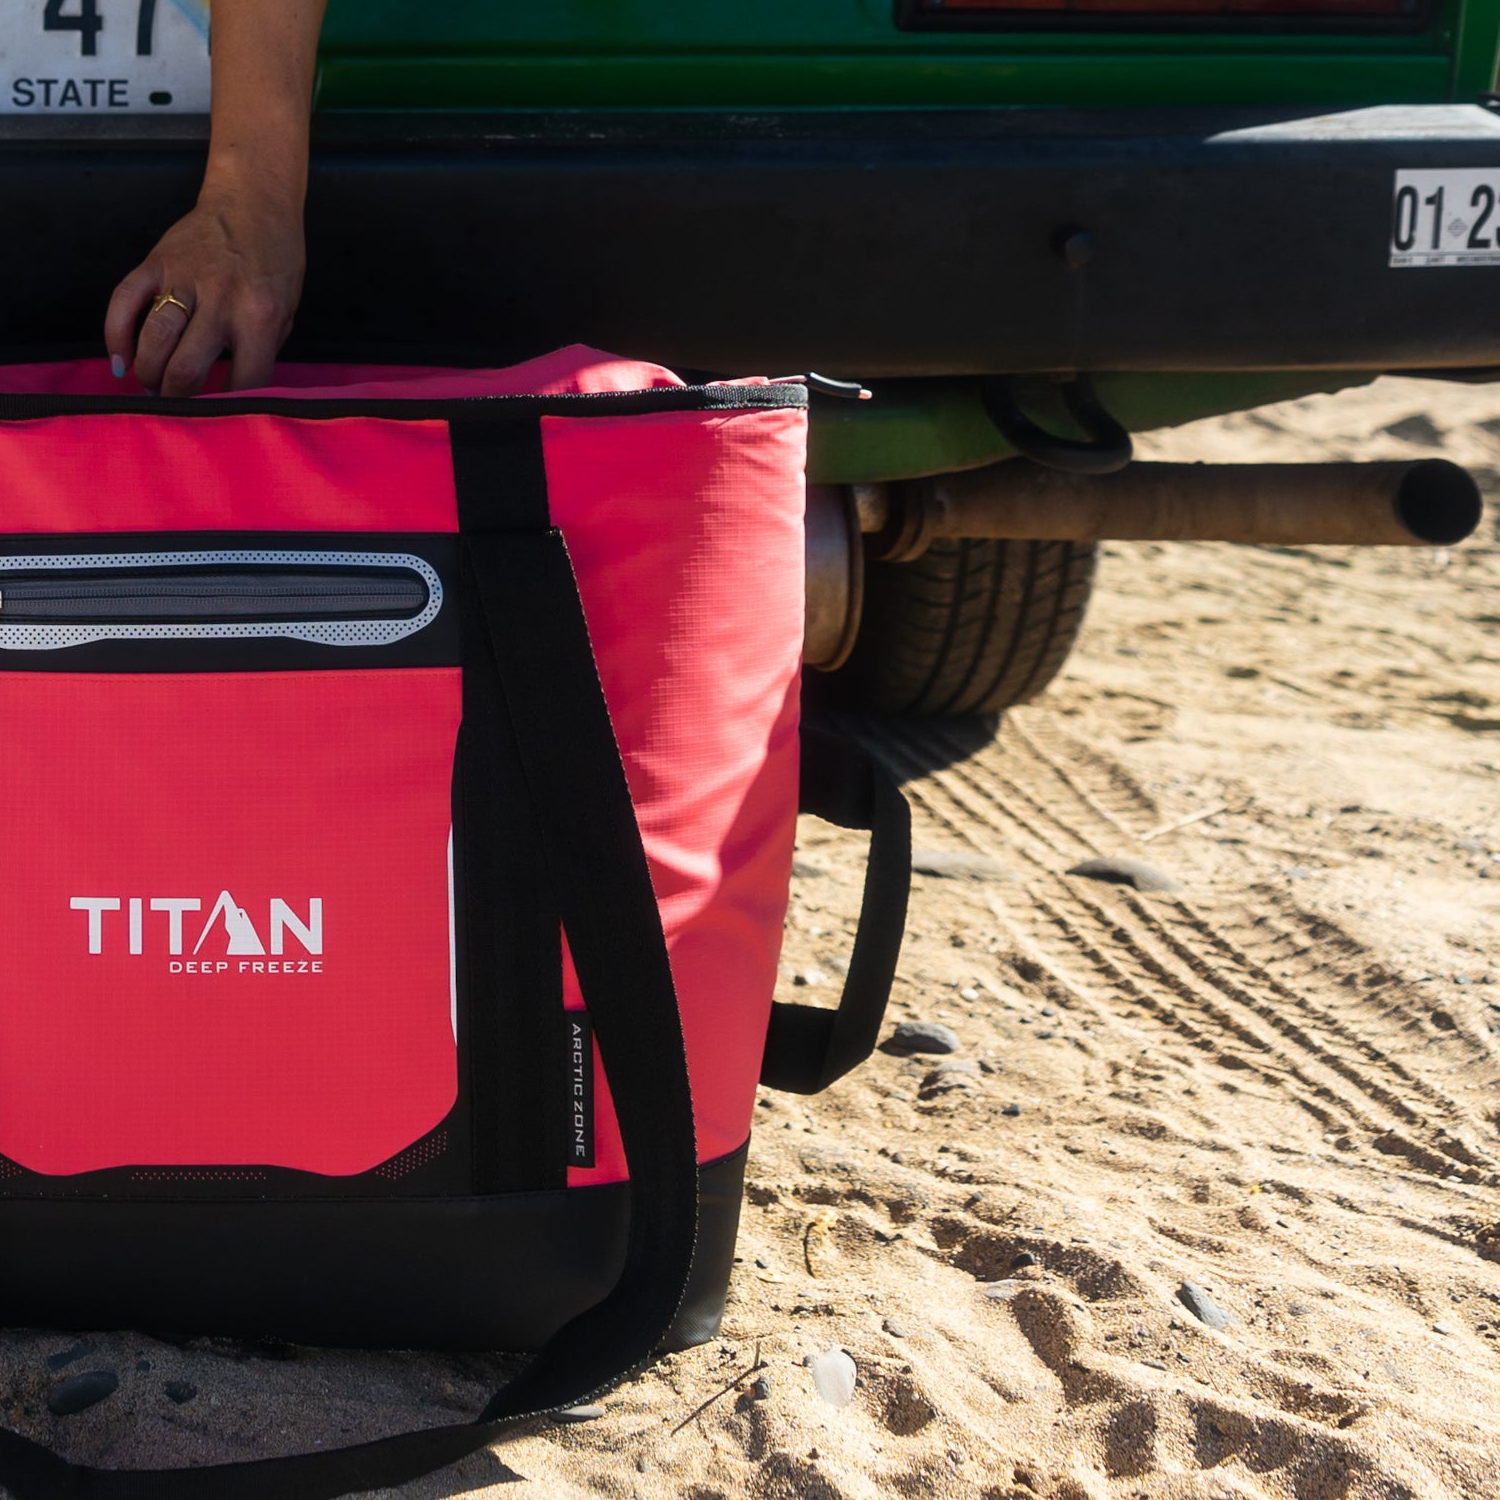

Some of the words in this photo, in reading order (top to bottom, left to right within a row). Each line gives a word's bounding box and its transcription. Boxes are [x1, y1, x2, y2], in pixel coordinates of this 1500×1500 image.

[12, 78, 129, 108] STATE
[1395, 185, 1444, 251] 01
[1466, 184, 1500, 250] 2
[70, 890, 323, 955] TITAN
[169, 961, 229, 973] DEEP
[238, 961, 323, 973] FREEZE
[572, 1023, 583, 1096] ARCTIC
[574, 1101, 586, 1157] ZONE
